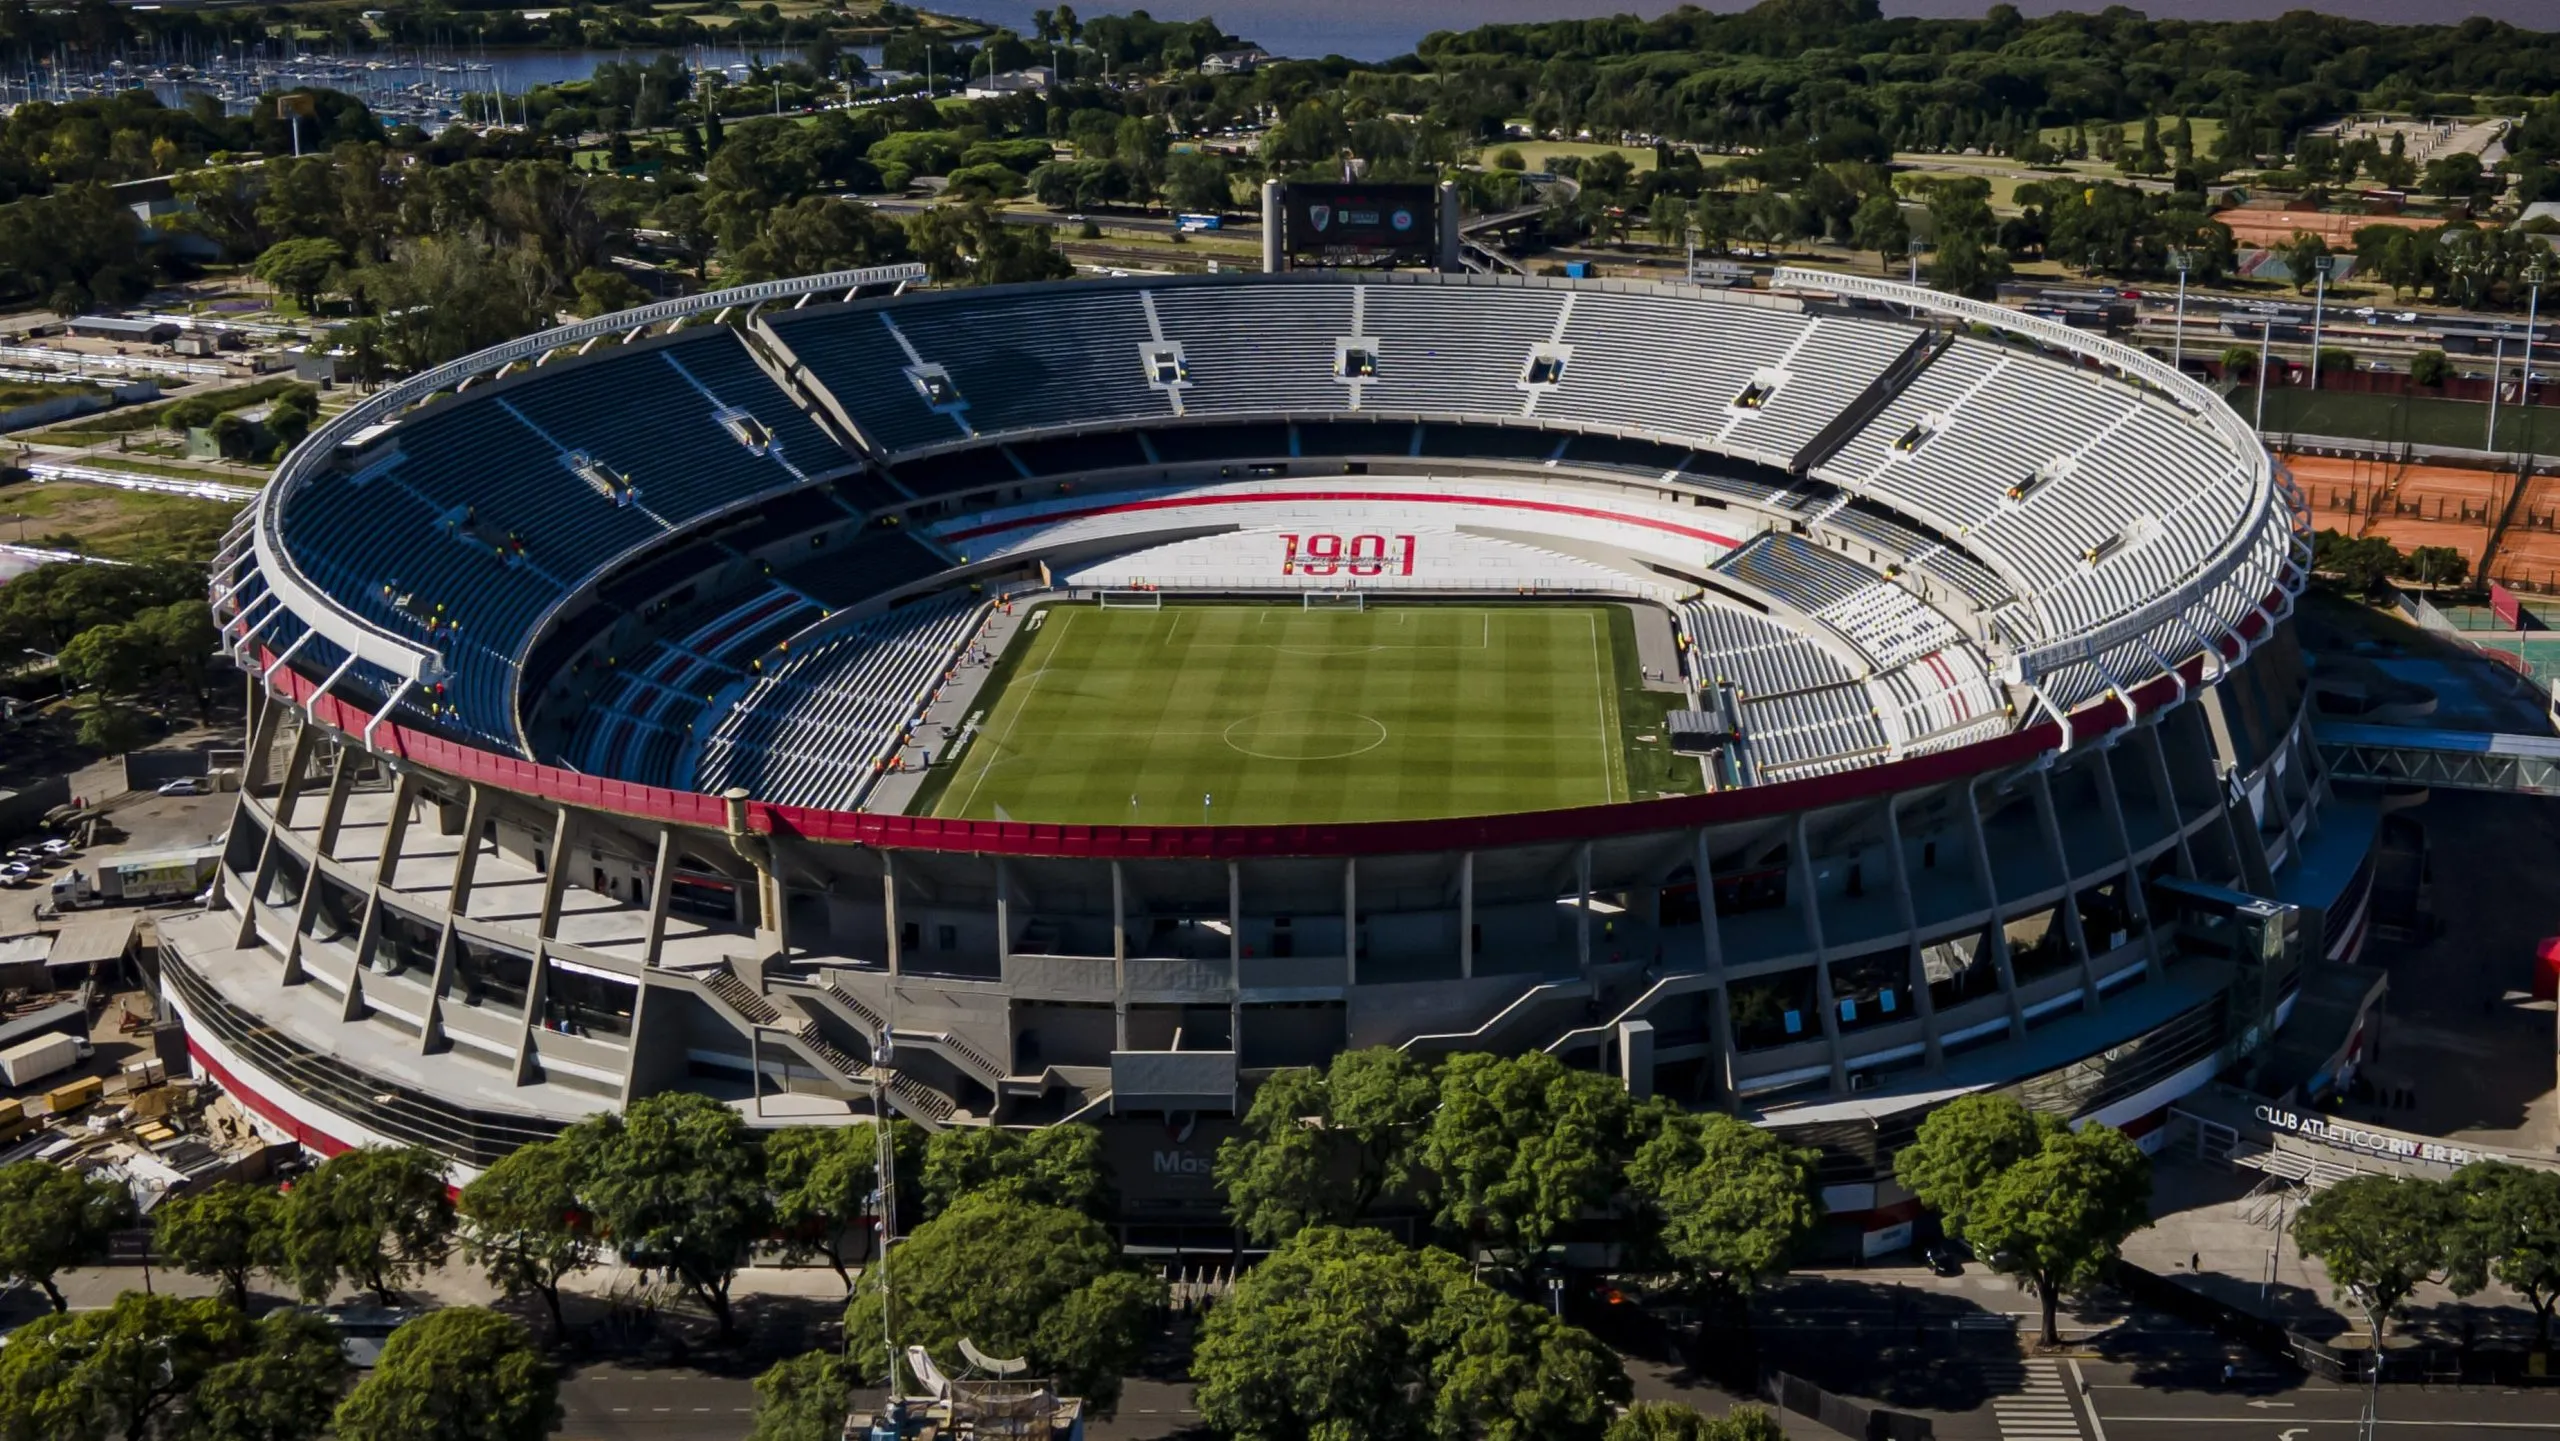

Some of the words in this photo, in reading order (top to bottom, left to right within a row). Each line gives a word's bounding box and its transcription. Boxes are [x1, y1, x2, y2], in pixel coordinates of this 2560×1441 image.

[1279, 534, 1416, 576] 1901
[2255, 1105, 2298, 1130] CLUB
[2299, 1118, 2385, 1150] ATLETICO
[2389, 1138, 2446, 1162] RIVER
